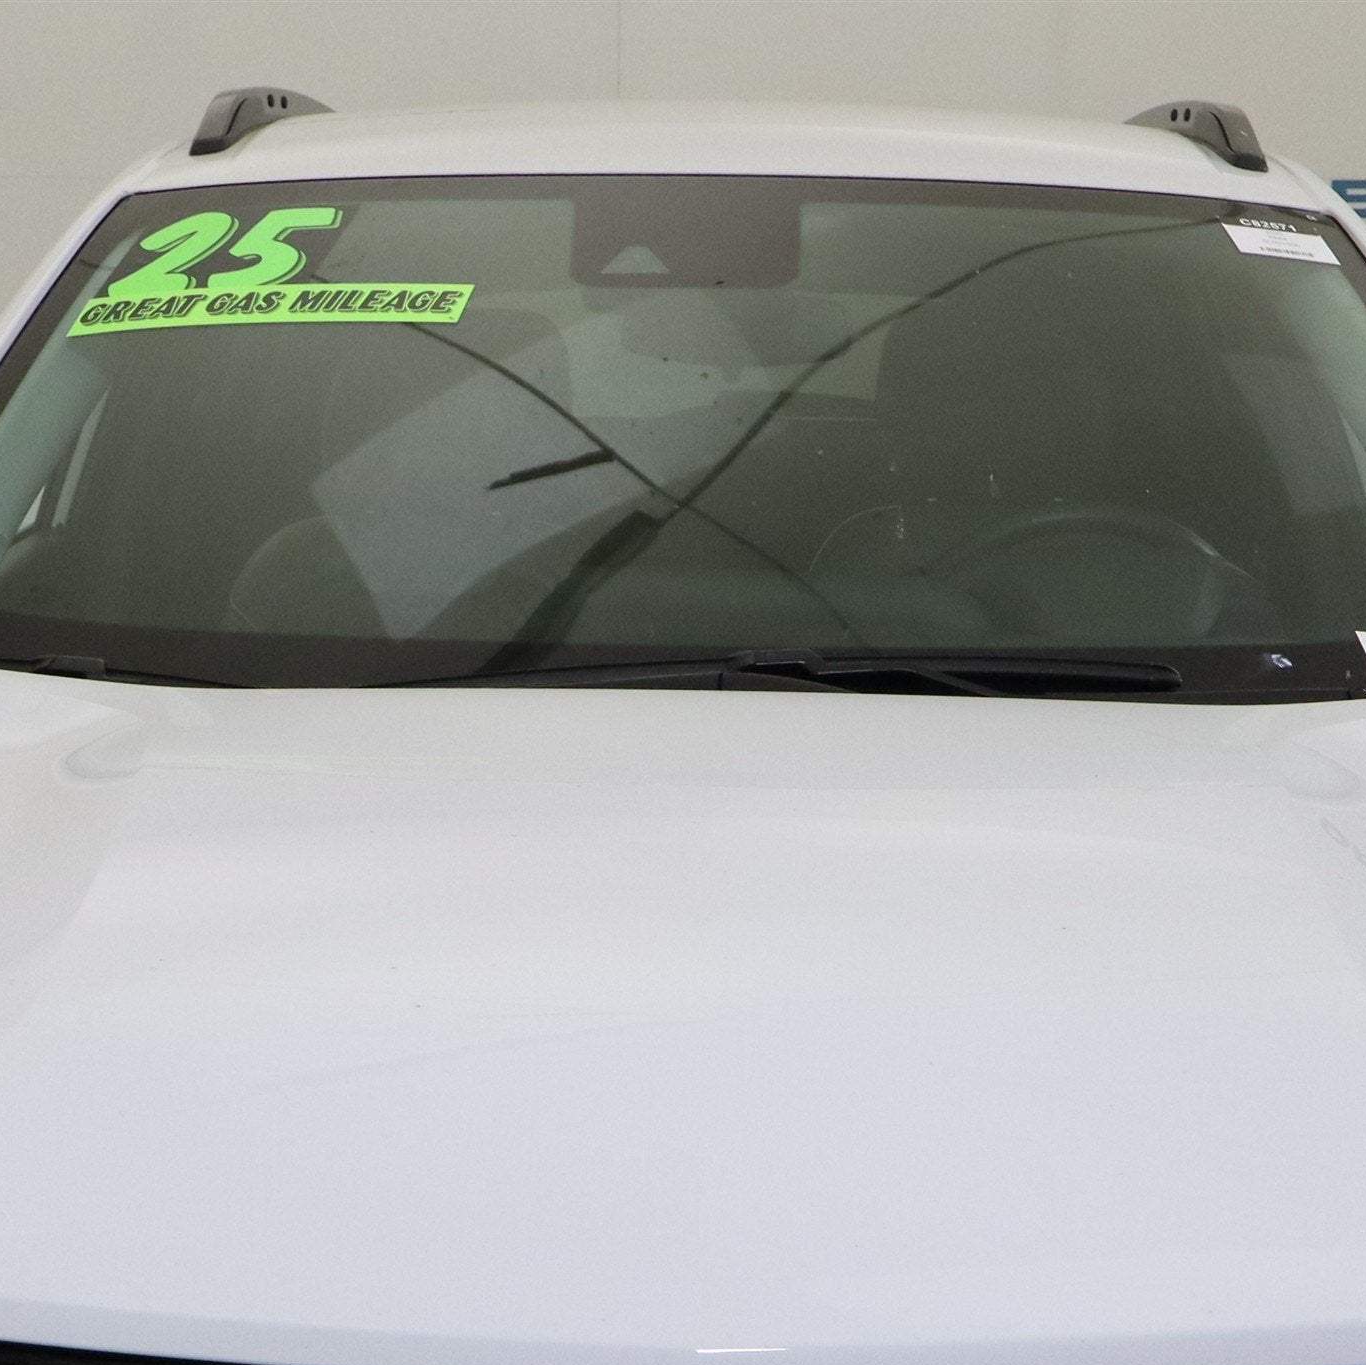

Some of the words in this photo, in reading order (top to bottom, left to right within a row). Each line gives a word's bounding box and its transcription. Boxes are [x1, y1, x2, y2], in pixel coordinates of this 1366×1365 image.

[107, 207, 343, 298] 25
[79, 293, 208, 326] GREAT
[206, 288, 283, 315] GAS
[288, 288, 464, 315] MILEAGE
